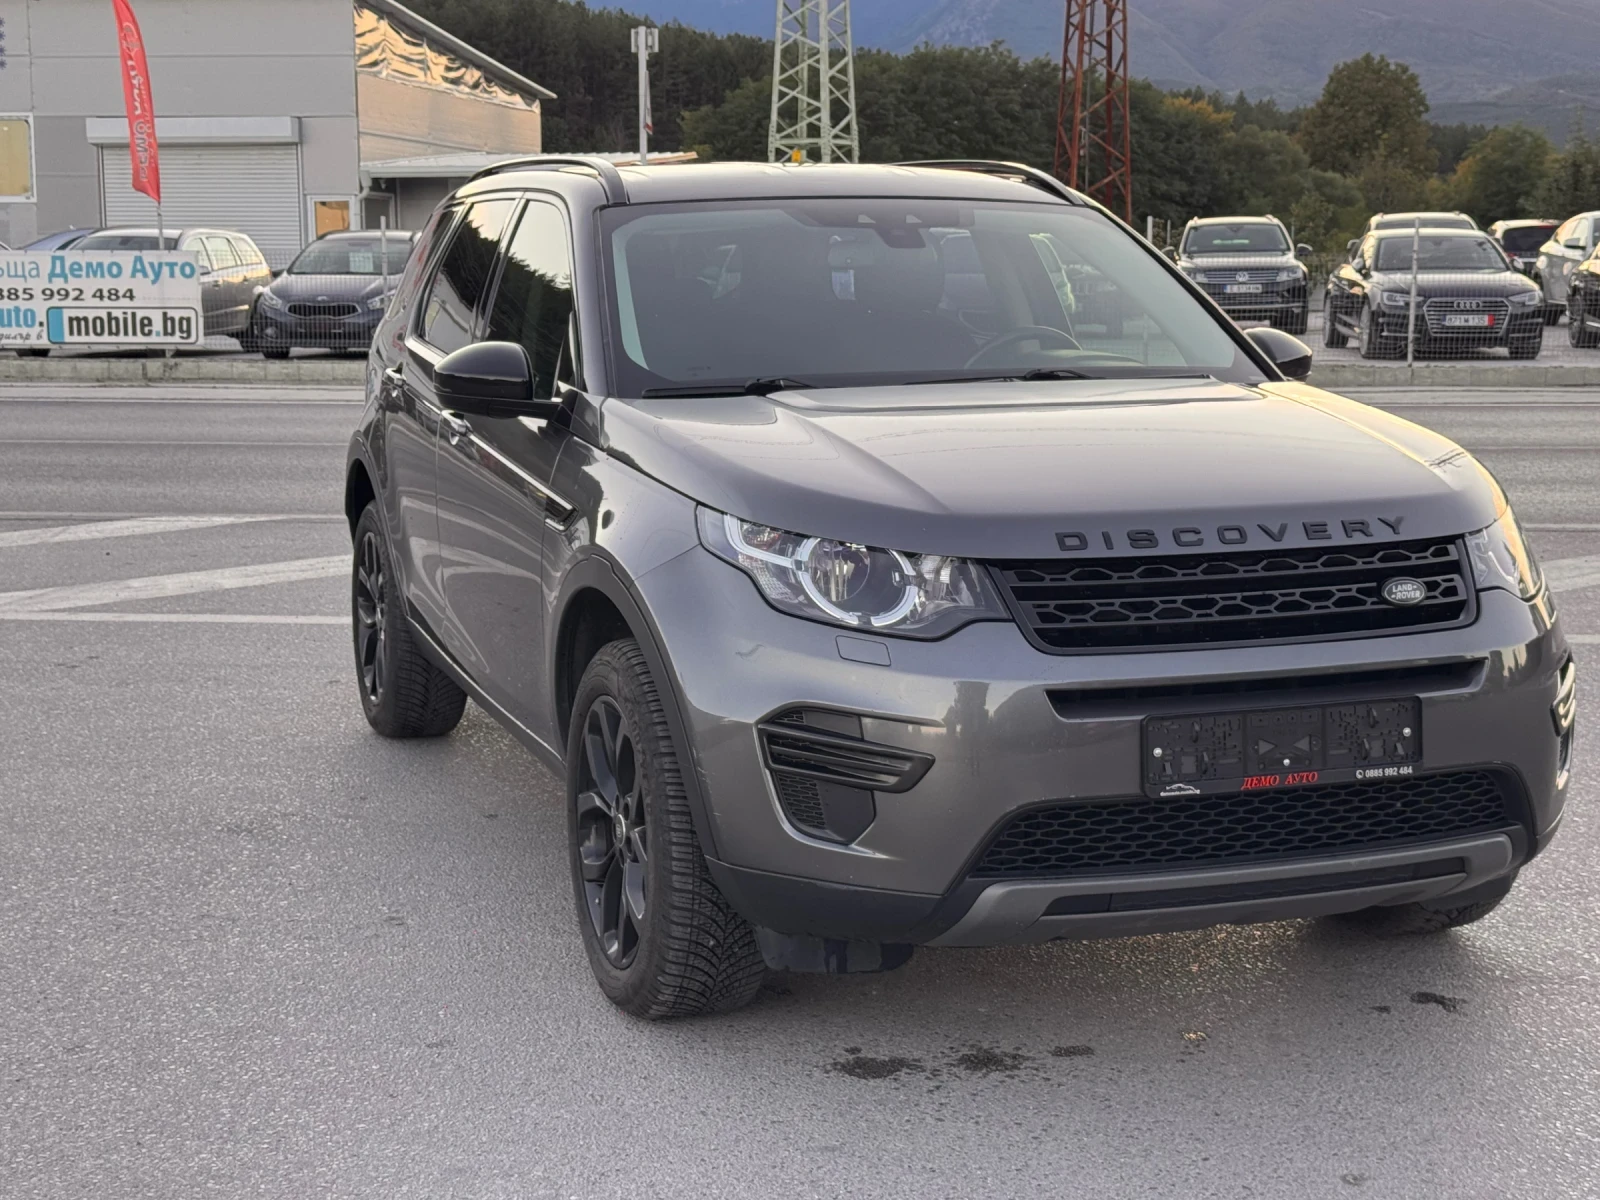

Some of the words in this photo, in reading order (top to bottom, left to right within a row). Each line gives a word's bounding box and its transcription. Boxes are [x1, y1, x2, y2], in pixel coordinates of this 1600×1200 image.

[47, 255, 123, 284] Демо
[130, 255, 196, 285] Ауто
[41, 287, 85, 301] 992
[91, 287, 136, 301] 484
[68, 311, 192, 340] mobile.bg
[1055, 516, 1405, 551] DISCOVERY
[1240, 775, 1280, 791] ДЕМО
[1284, 771, 1319, 785] АУТО
[1365, 768, 1383, 778] 0885
[1384, 767, 1398, 776] 992
[1398, 765, 1413, 775] 484
